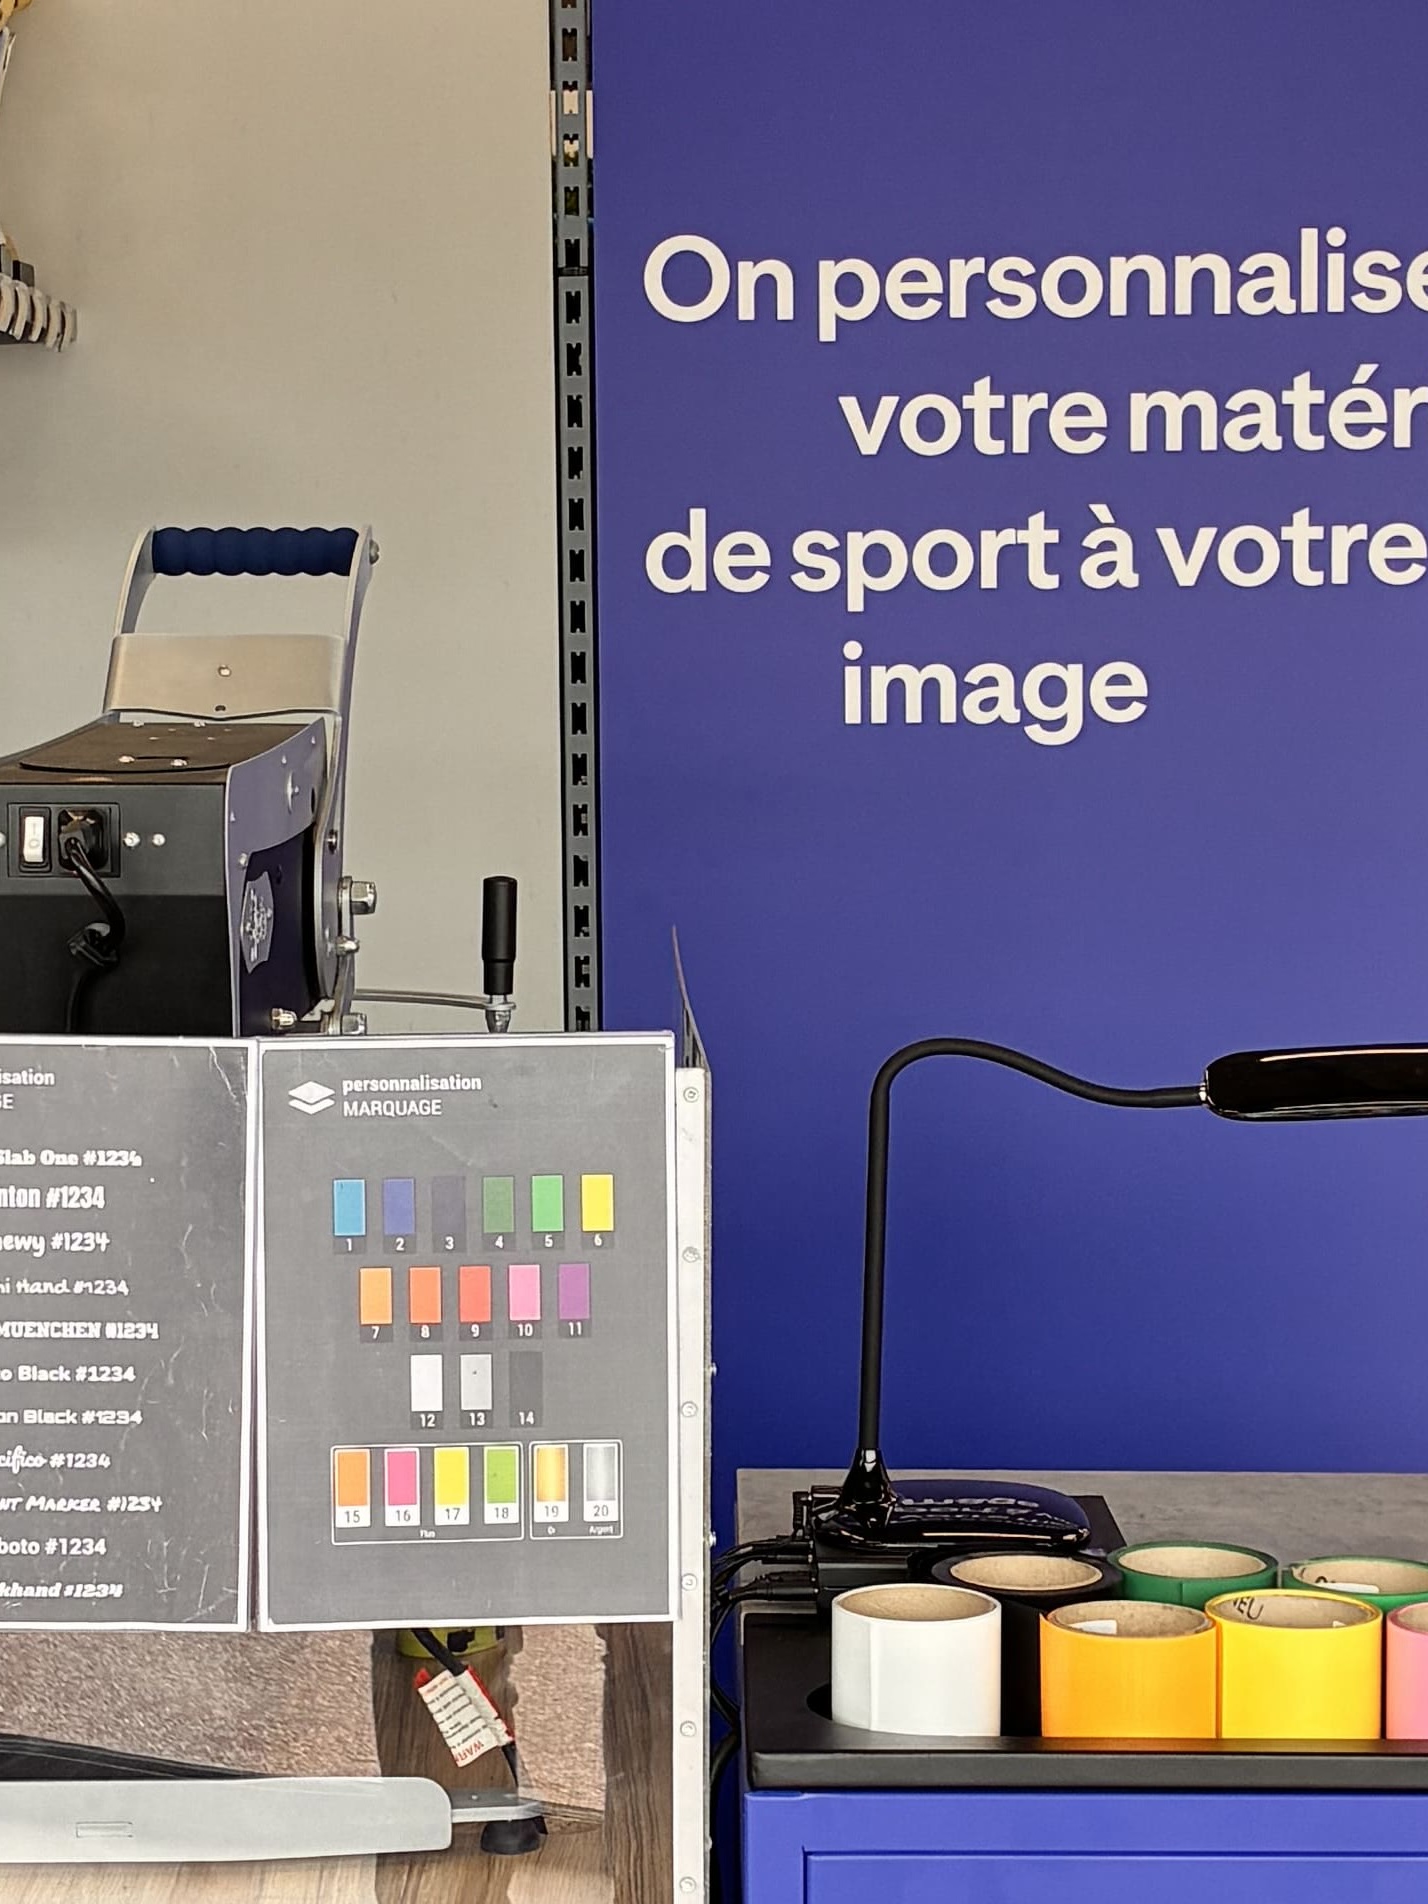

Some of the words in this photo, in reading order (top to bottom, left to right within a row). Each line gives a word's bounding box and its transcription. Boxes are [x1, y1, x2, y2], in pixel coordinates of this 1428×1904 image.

[643, 233, 795, 324] On
[839, 376, 1109, 457] votre
[643, 508, 772, 594] de
[790, 510, 1060, 613] sport
[1081, 512, 1140, 591] à
[1158, 508, 1428, 589] votre
[842, 639, 1149, 747] image
[342, 1074, 482, 1094] personnalisation
[343, 1098, 443, 1117] MARQUAGE
[40, 1149, 79, 1165] One
[83, 1151, 143, 1167] #1234
[46, 1185, 105, 1209] #1234
[50, 1232, 110, 1252] #1234
[344, 1238, 354, 1252] 1
[394, 1236, 405, 1251] 2
[444, 1235, 454, 1250] 3
[494, 1235, 504, 1249] 4
[544, 1234, 554, 1249] 5
[593, 1233, 603, 1248] 6
[16, 1278, 70, 1294] Hand
[73, 1279, 129, 1296] #1234
[370, 1325, 381, 1339] 7
[420, 1324, 430, 1339] 8
[470, 1323, 480, 1338] 9
[517, 1322, 534, 1337] 10
[568, 1321, 583, 1335] 11
[18, 1365, 71, 1381] Black
[75, 1366, 137, 1382] #1234
[23, 1409, 78, 1424] Black
[81, 1410, 143, 1425] #1234
[418, 1413, 437, 1428] 12
[467, 1412, 486, 1426] 13
[517, 1411, 535, 1426] 14
[49, 1453, 112, 1469] #1234
[107, 1496, 164, 1513] #1234
[545, 1505, 559, 1517] 19
[593, 1505, 609, 1517] 20
[344, 1510, 360, 1523] 15
[395, 1509, 411, 1522] 16
[445, 1508, 460, 1521] 17
[494, 1507, 509, 1519] 18
[45, 1538, 107, 1555] #1234
[63, 1583, 124, 1598] #1234
